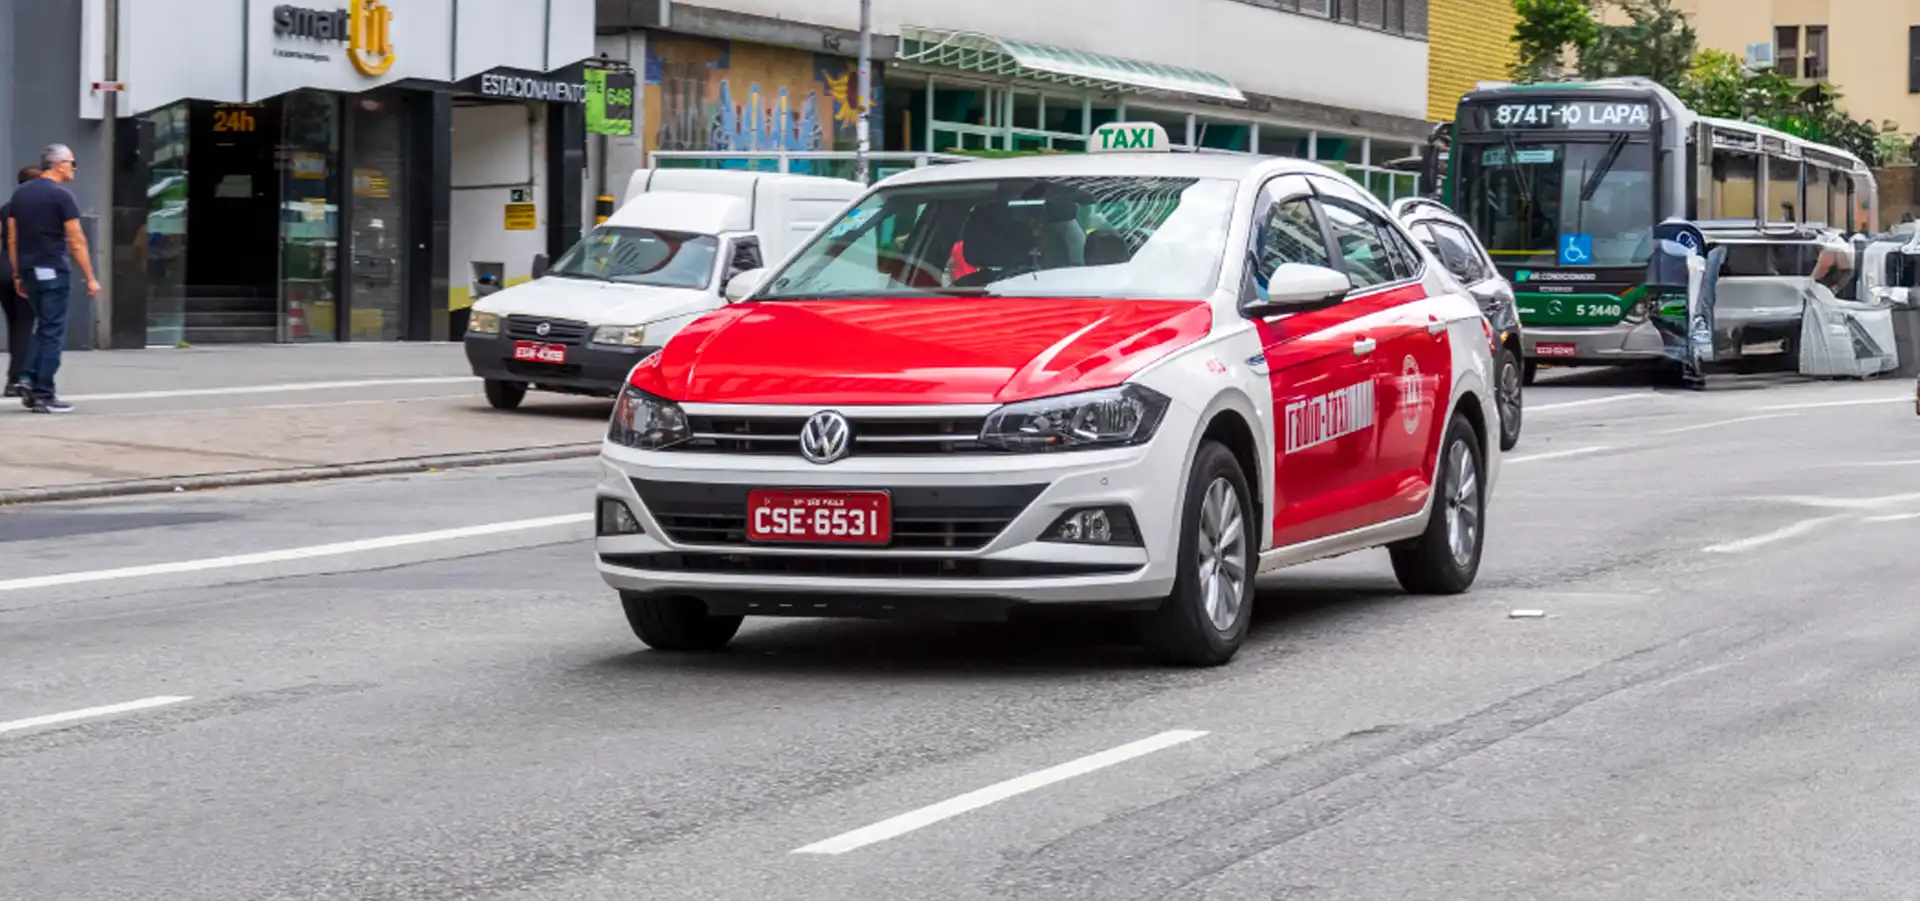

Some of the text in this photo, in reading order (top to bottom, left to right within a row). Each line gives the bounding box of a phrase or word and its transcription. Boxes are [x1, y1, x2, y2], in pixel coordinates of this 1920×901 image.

[349, 0, 394, 60] fit
[482, 73, 587, 103] ESTACIONAMENTO
[213, 109, 256, 131] 24h
[1496, 104, 1648, 125] 874T-10 LAPA
[1098, 128, 1155, 149] TAXI
[1576, 304, 1621, 317] 5 2440
